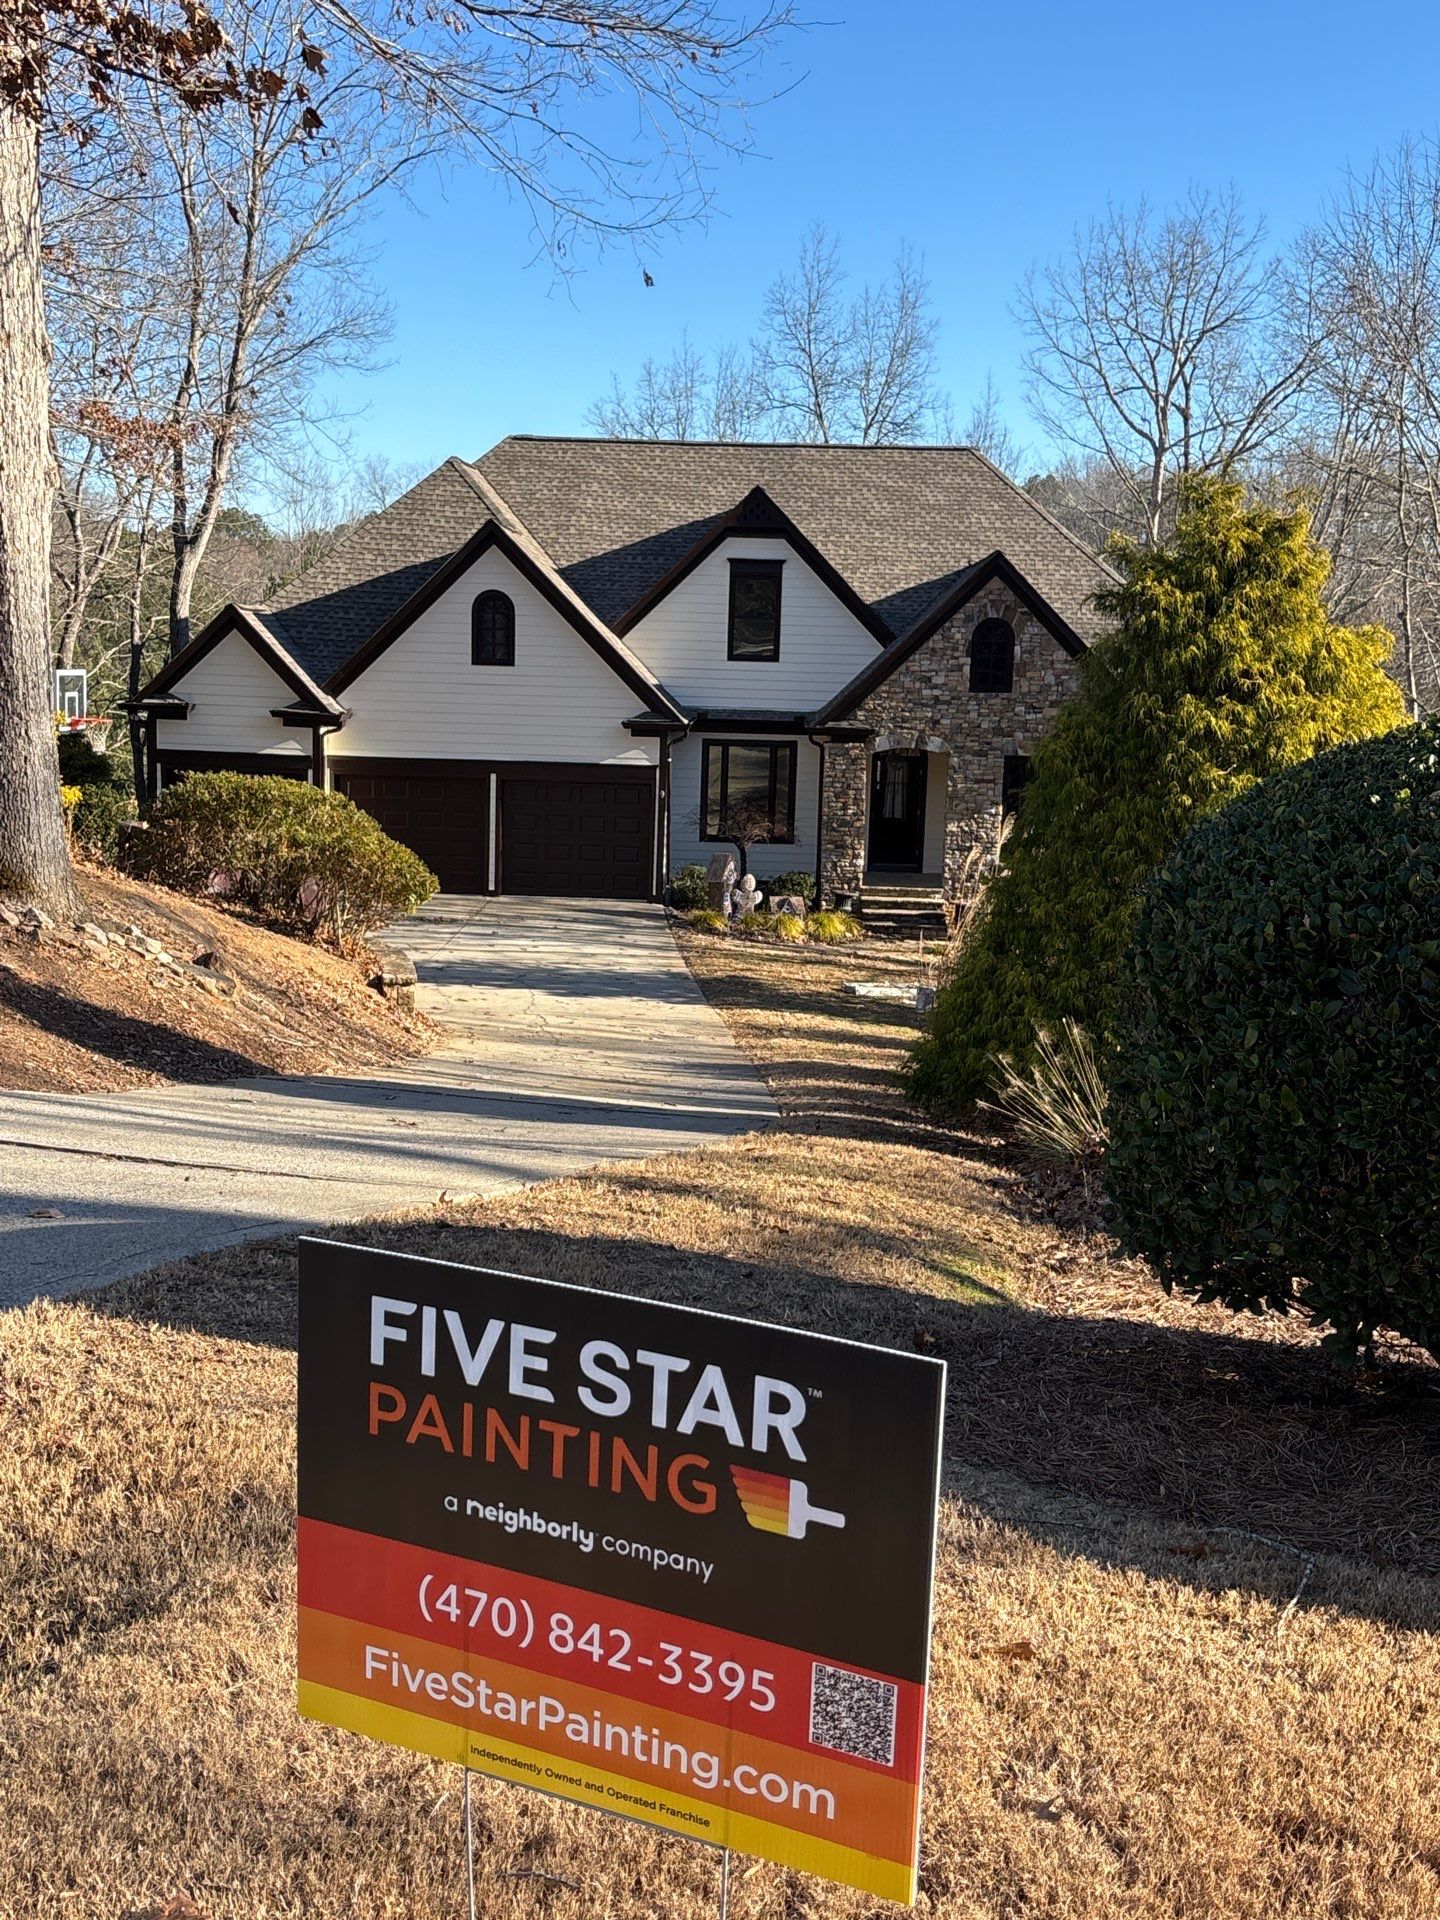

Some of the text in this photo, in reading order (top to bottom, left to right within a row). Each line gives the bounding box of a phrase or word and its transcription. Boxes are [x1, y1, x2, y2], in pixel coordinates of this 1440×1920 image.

[370, 1295, 557, 1404] FIVE
[577, 1340, 807, 1462] STAR
[368, 1382, 718, 1515] PAINTING
[444, 1495, 714, 1584] a neighborly company
[418, 1573, 776, 1713] (470) 842-3395
[364, 1645, 836, 1820] FiveStarPainting.com
[470, 1744, 711, 1828] Independently Owned and Operated Franchise
